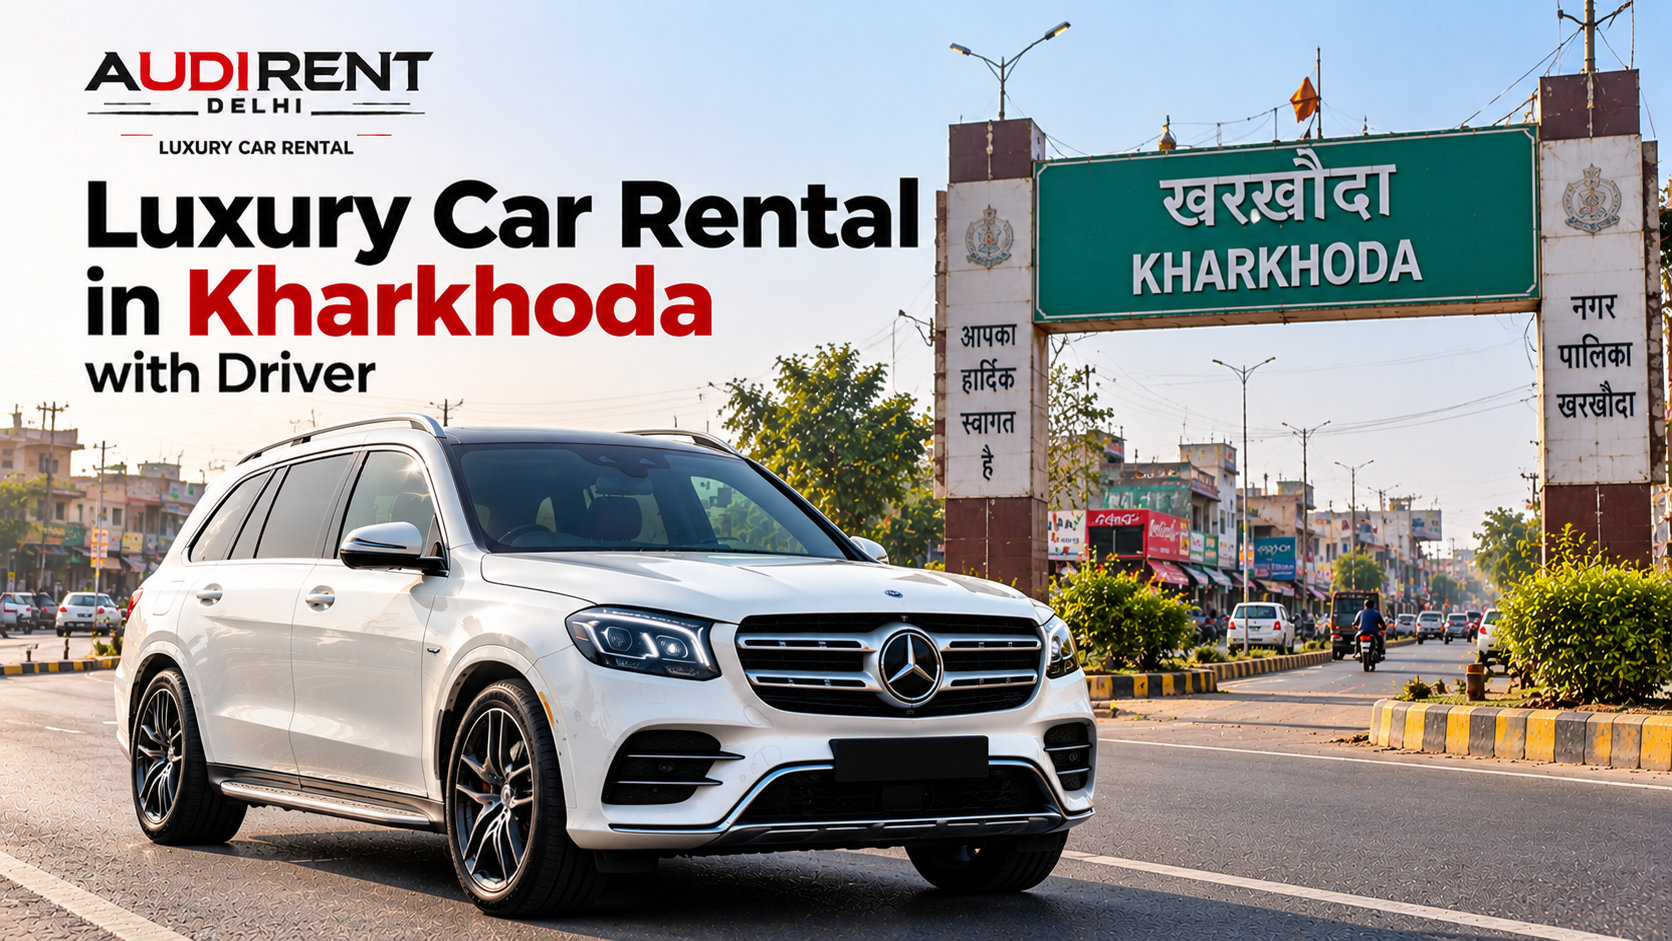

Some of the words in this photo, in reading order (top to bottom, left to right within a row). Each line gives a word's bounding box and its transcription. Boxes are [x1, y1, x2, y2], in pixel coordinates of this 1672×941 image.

[1132, 238, 1424, 296] KHARKHODA
[1570, 294, 1618, 321] नगर
[961, 323, 1018, 349] आपका
[1557, 333, 1634, 369] पालिका
[960, 358, 1017, 395] हार्दिक
[1556, 381, 1637, 419] खरखौदा
[960, 411, 1017, 436] स्वागत
[981, 444, 995, 481] है
